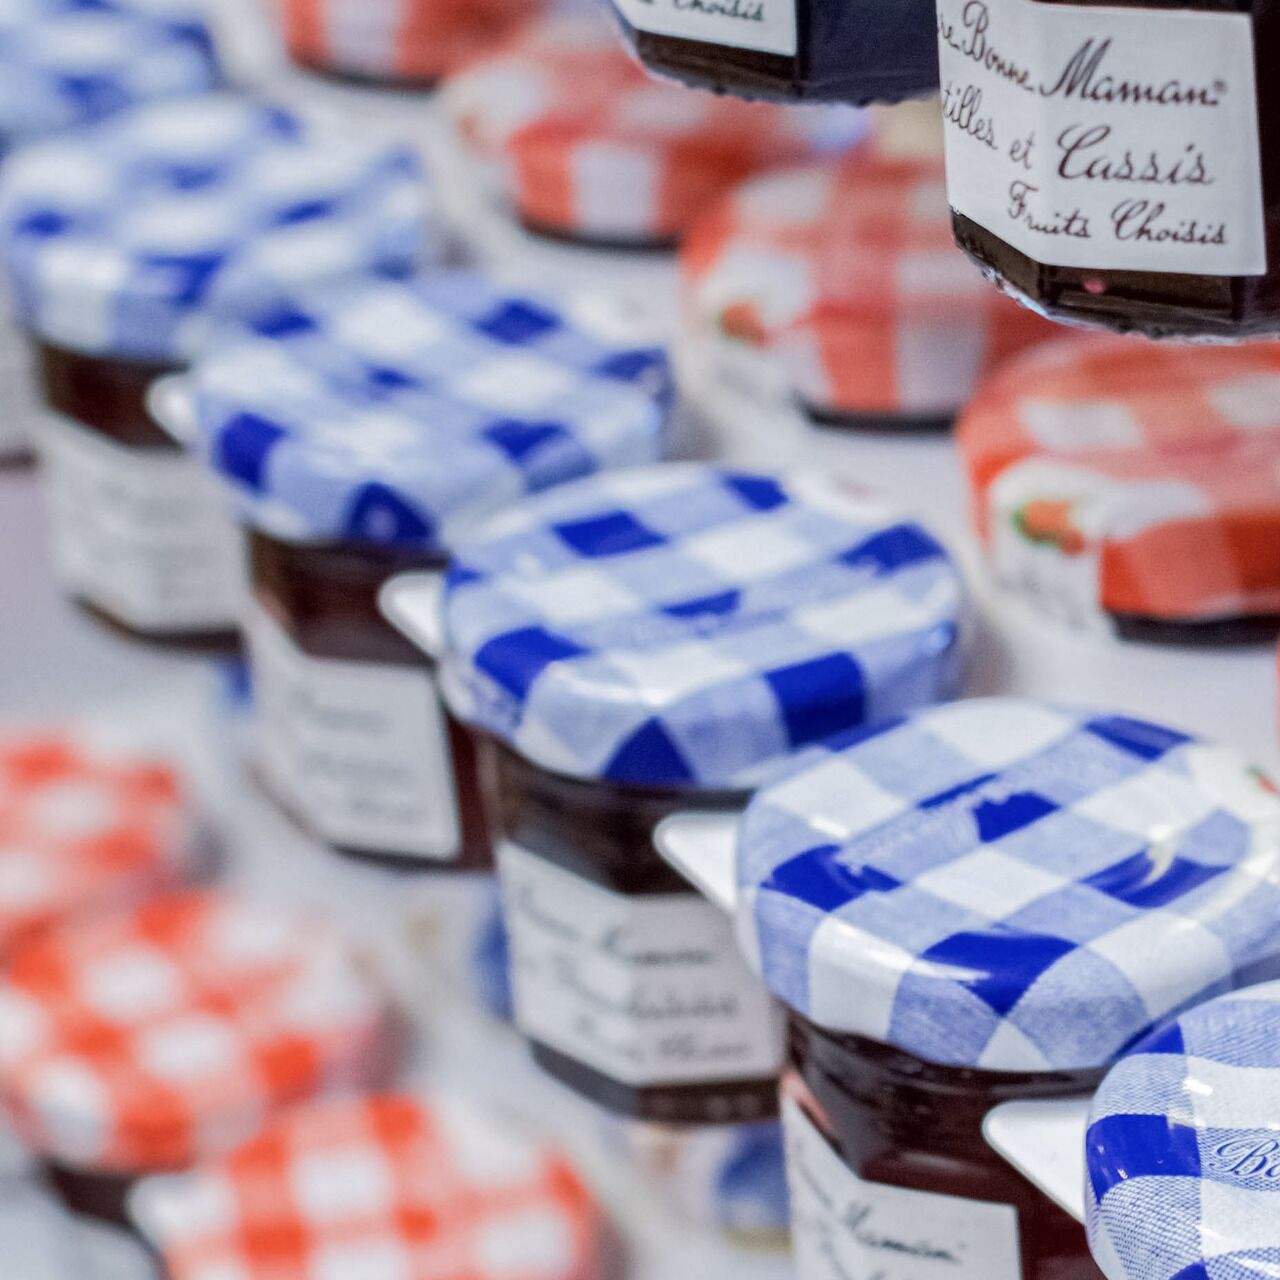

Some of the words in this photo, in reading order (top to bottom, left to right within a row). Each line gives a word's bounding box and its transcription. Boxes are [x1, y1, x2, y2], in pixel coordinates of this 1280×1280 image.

[961, 0, 1033, 93] Bonne
[943, 79, 999, 151] tilles
[1009, 131, 1036, 170] et
[1056, 123, 1215, 185] Cassis
[1008, 180, 1091, 240] Fruits
[1110, 198, 1229, 246] Choisis
